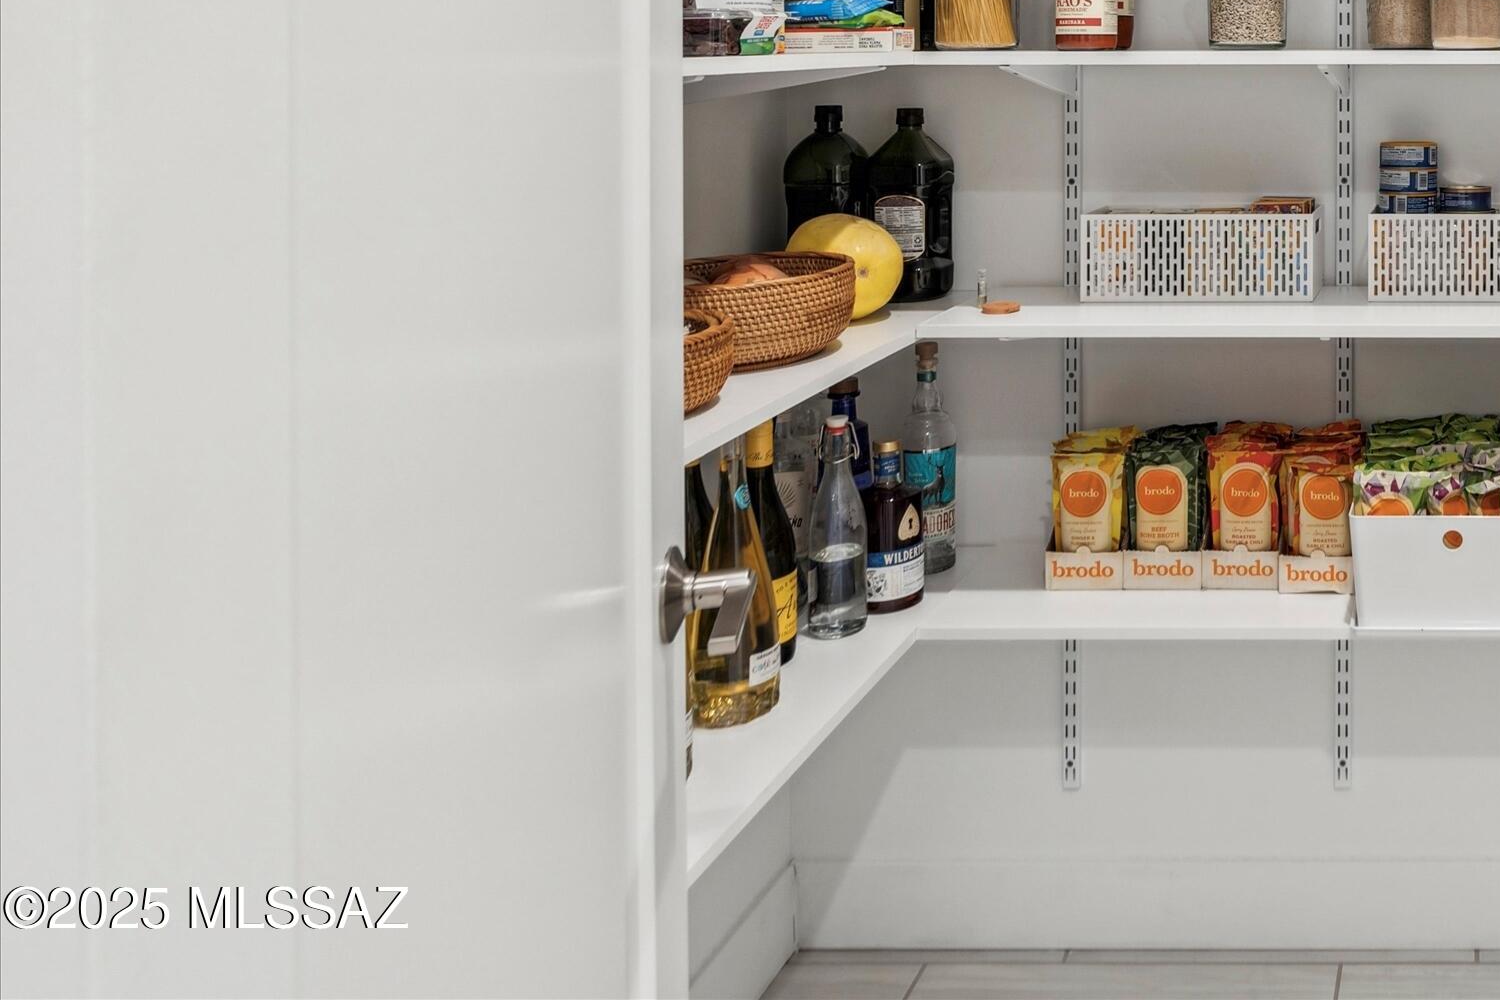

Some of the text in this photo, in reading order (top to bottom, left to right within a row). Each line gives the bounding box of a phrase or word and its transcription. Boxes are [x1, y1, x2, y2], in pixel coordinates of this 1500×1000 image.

[1068, 488, 1099, 498] brodo
[1144, 486, 1175, 496] brodo
[1231, 487, 1260, 497] brodo
[1310, 491, 1339, 501] brodo
[1052, 560, 1114, 579] brodo
[1133, 559, 1194, 577] brodo
[1213, 558, 1273, 577] brodo
[1286, 564, 1348, 583] brodo
